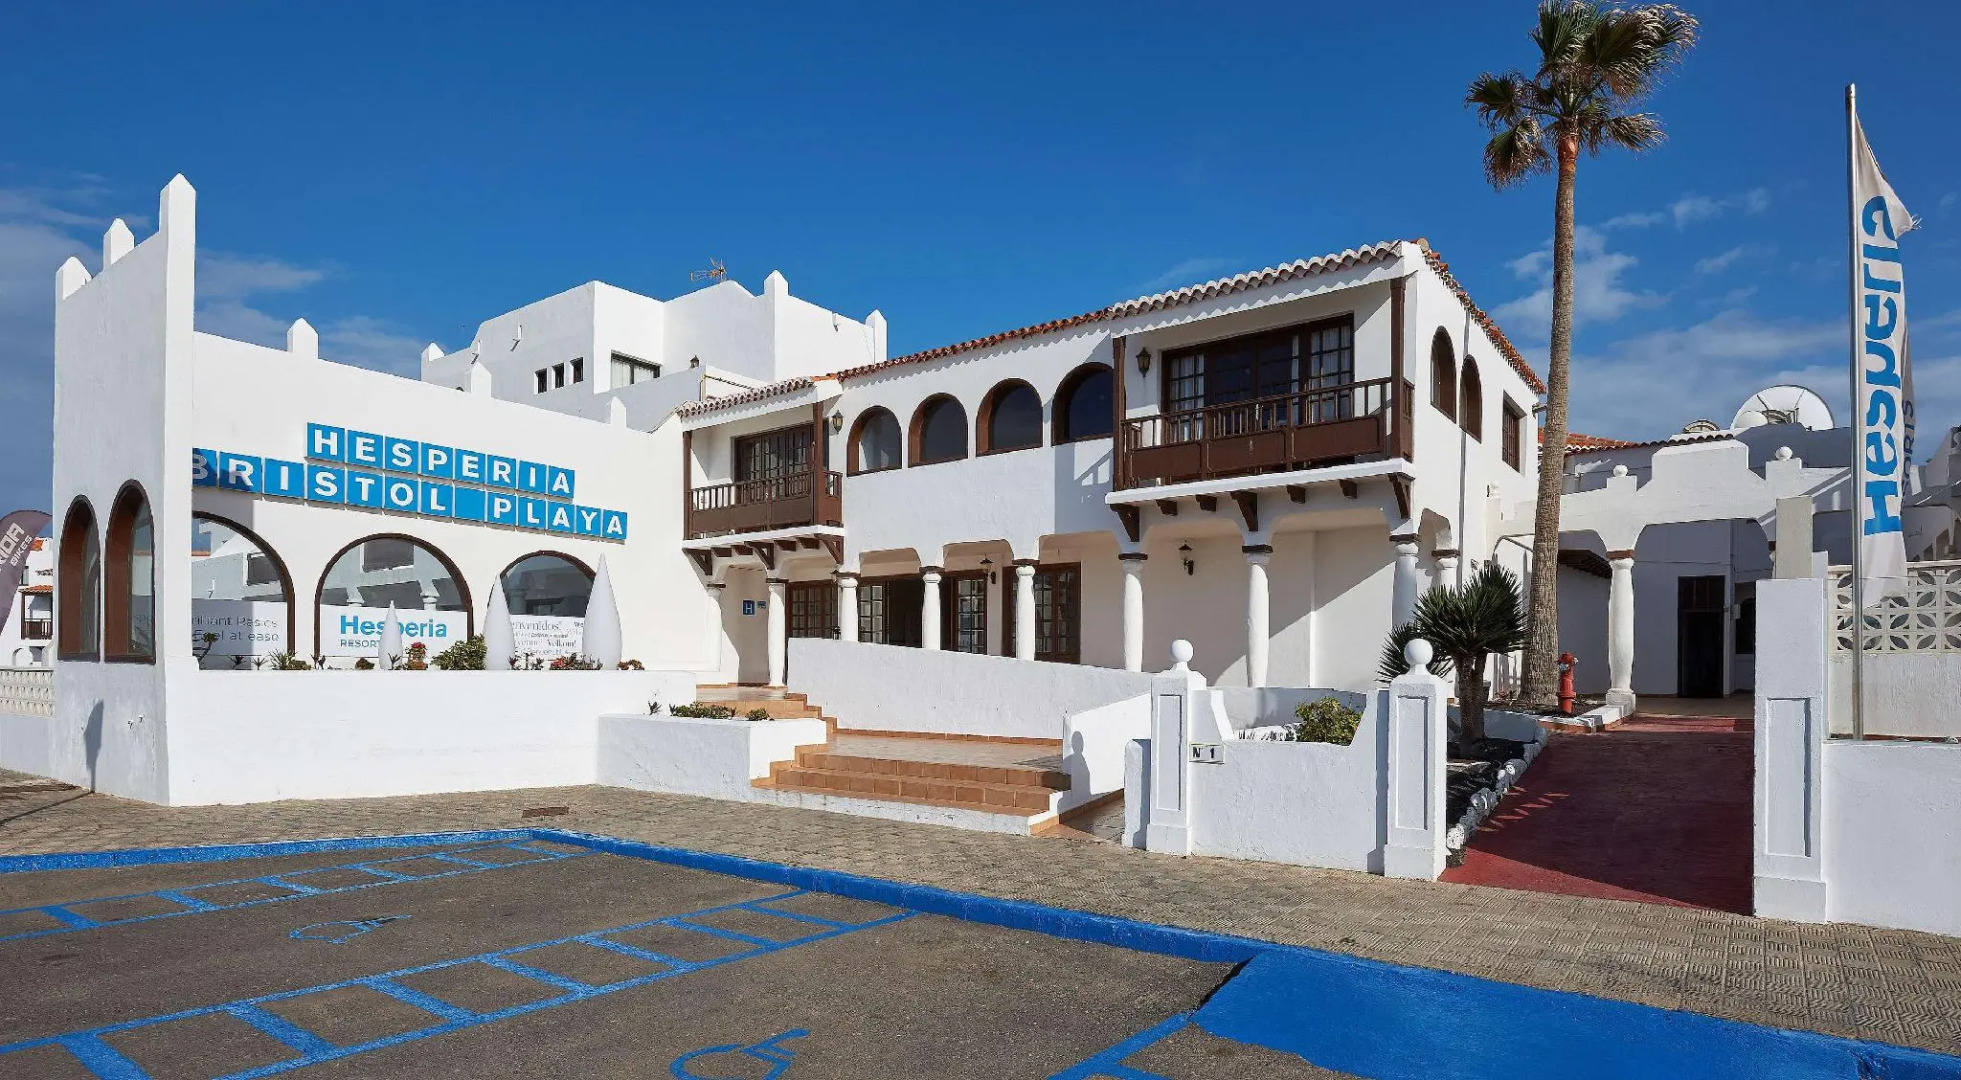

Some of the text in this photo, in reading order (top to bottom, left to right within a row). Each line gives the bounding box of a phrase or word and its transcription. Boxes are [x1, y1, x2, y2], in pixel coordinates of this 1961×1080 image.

[1862, 195, 1901, 536] Hesperia
[314, 429, 571, 494] HESPERIA
[192, 453, 623, 535] BRISTOL PLAYA
[10, 535, 32, 566] BIKES
[192, 613, 278, 628] rilliant Basics
[194, 629, 280, 642] Fel at ease
[340, 639, 381, 648] RESORT
